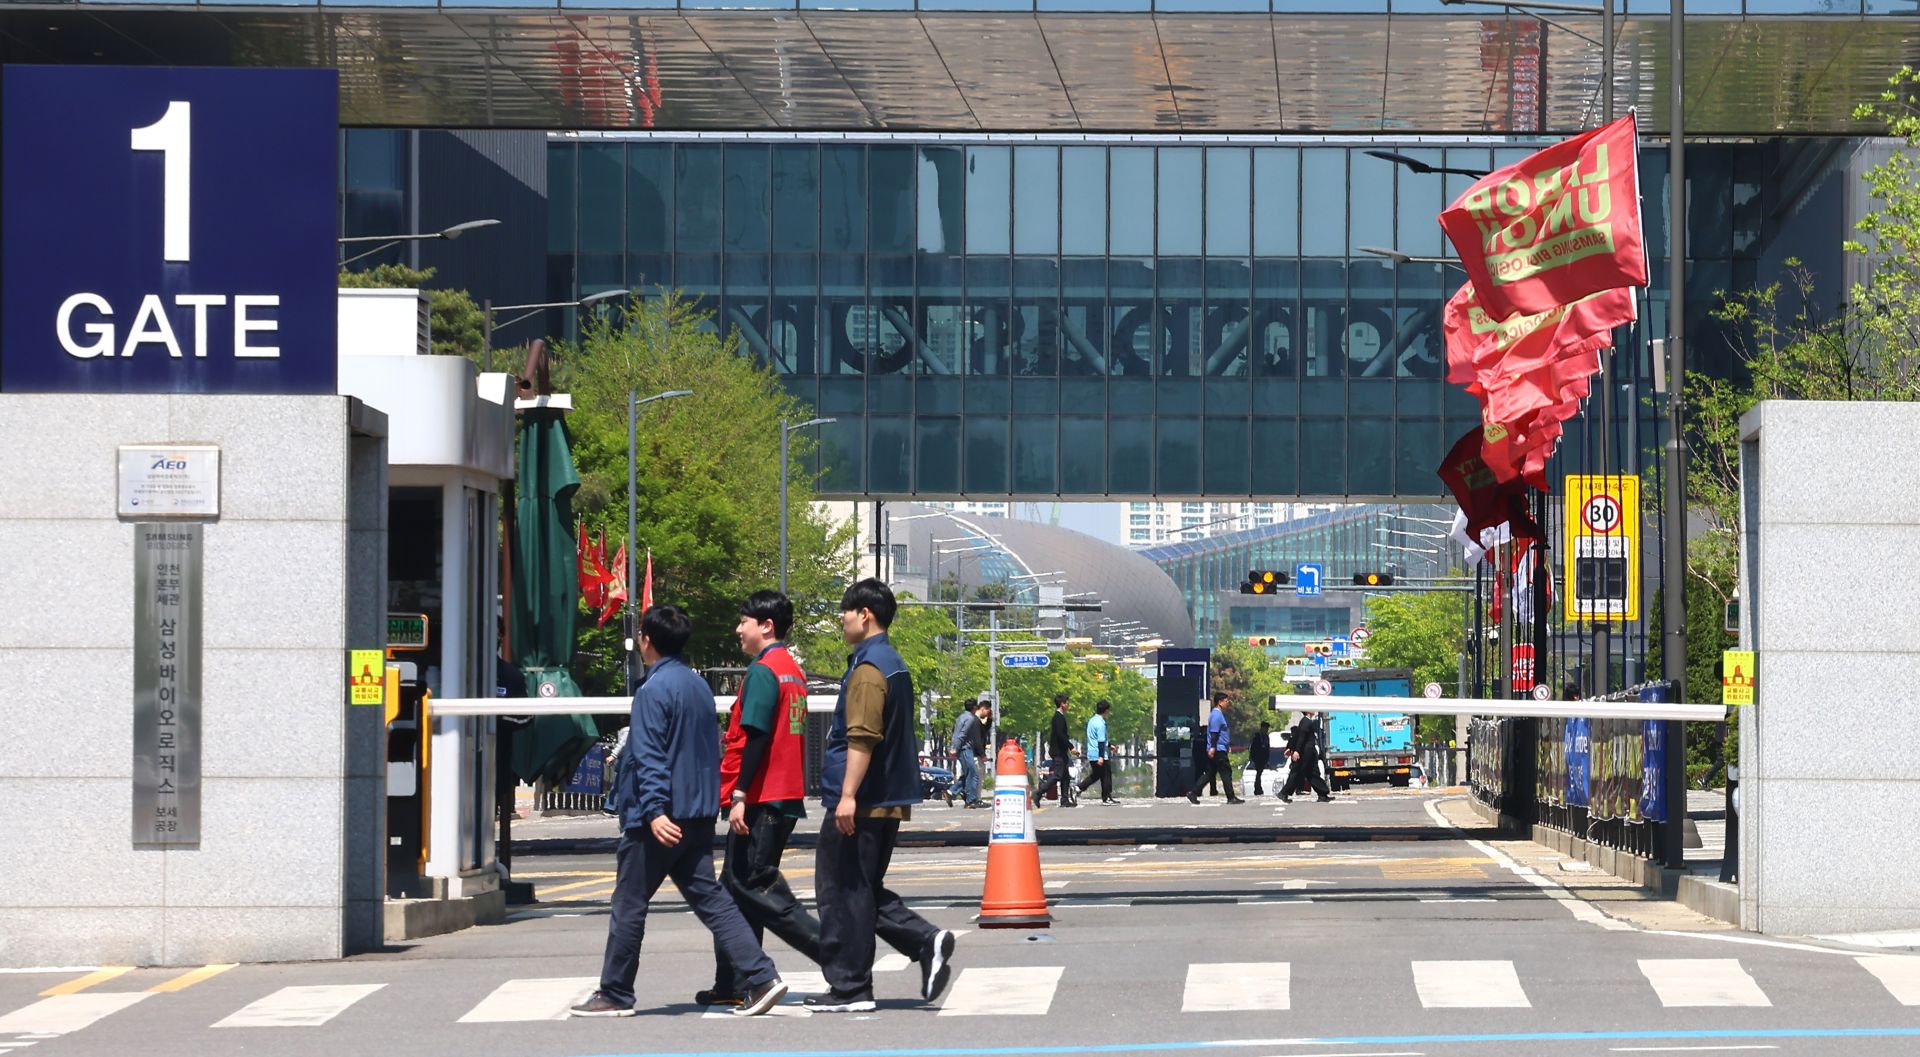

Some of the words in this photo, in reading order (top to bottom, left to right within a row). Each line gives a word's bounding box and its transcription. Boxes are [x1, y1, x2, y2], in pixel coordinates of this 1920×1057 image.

[131, 101, 190, 261] 1
[56, 292, 281, 358] GATE
[151, 458, 187, 470] AEO
[1590, 505, 1614, 522] 30
[145, 533, 193, 542] SAMSUNG
[157, 563, 180, 576] 인천
[158, 618, 177, 794] 삼성바이오로직스
[156, 806, 178, 818] 보세
[155, 820, 177, 832] 공장
